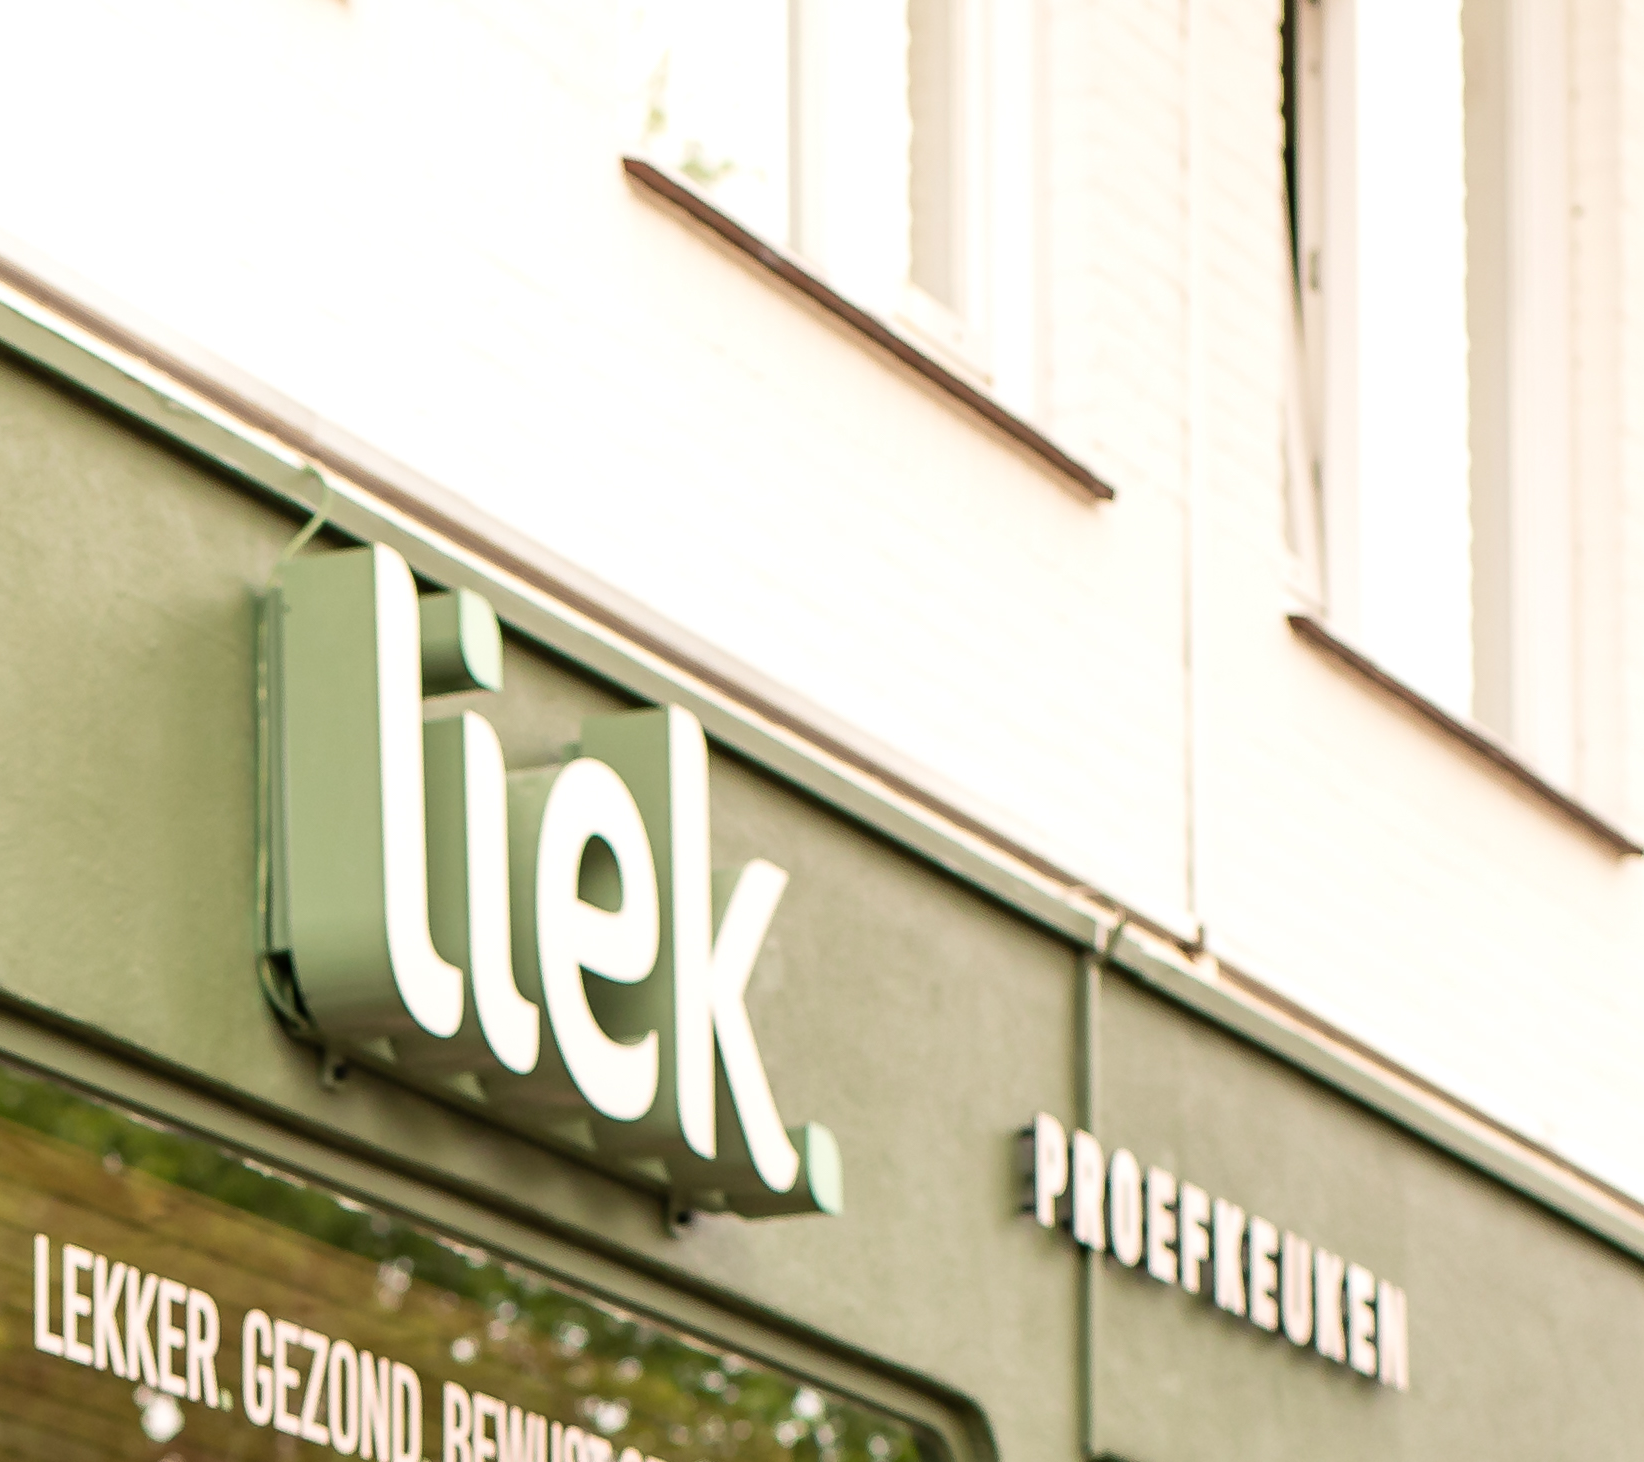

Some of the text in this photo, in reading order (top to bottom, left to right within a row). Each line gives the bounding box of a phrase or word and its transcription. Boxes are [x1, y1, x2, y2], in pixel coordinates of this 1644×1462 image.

[373, 542, 843, 1214] liek.
[33, 1234, 233, 1413] LEKKER.
[1034, 1110, 1409, 1392] PROEFKEUKEN
